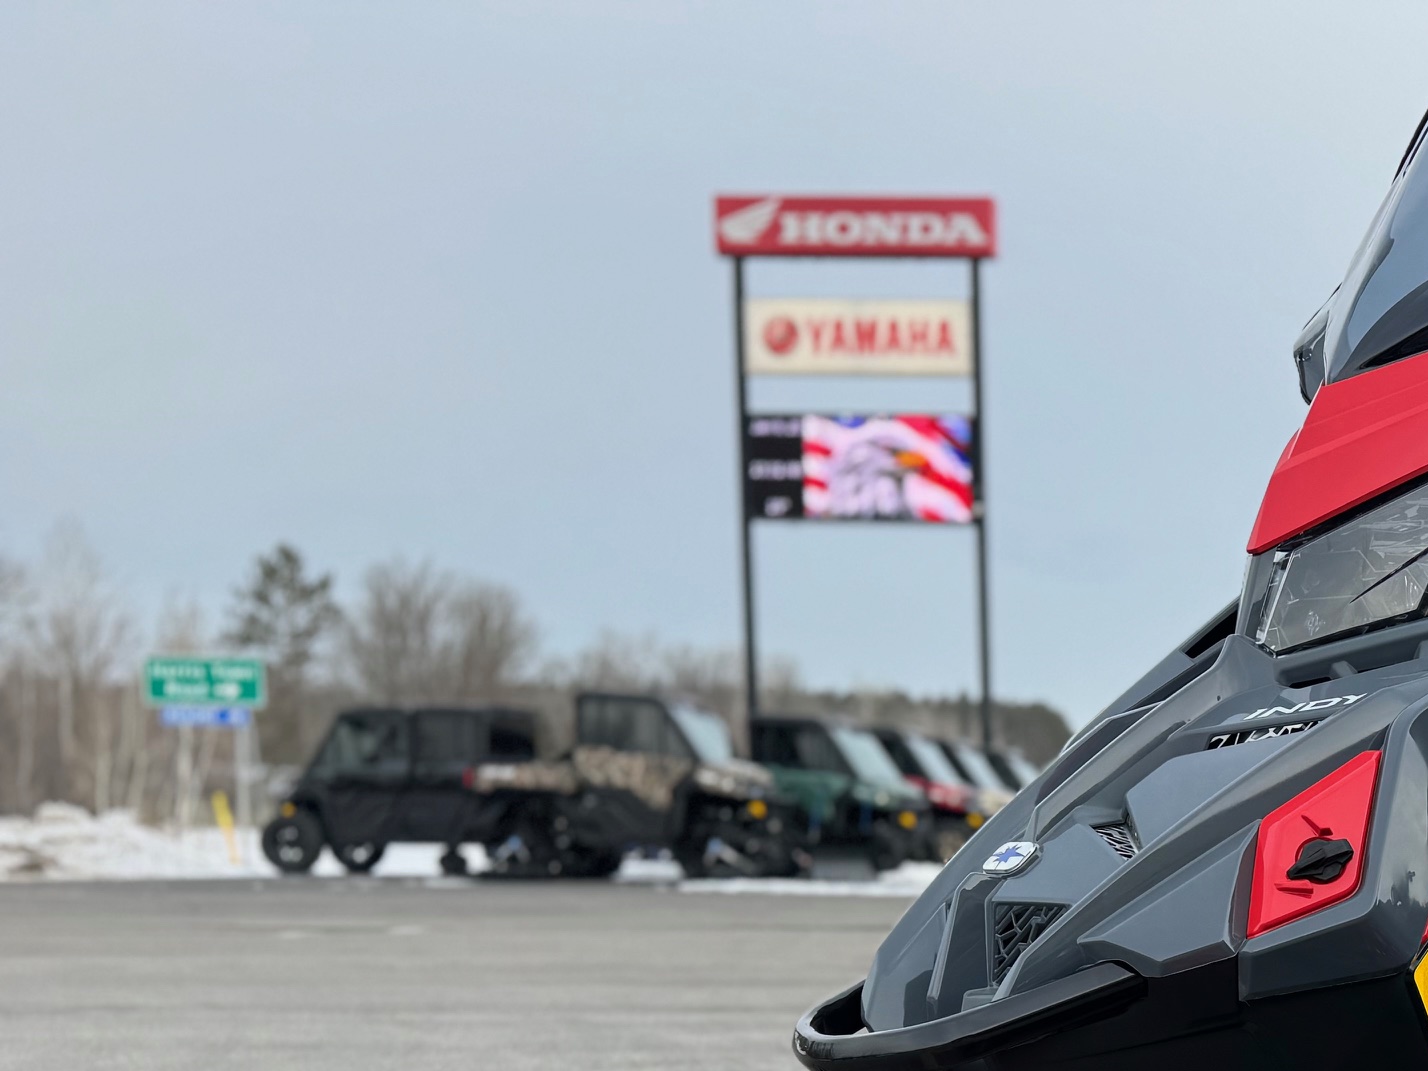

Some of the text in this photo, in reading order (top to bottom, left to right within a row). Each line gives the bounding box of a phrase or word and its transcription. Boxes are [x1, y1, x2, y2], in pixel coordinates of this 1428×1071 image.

[778, 211, 988, 247] HONDA
[807, 317, 957, 357] YAMAHA
[1243, 693, 1368, 720] INDY
